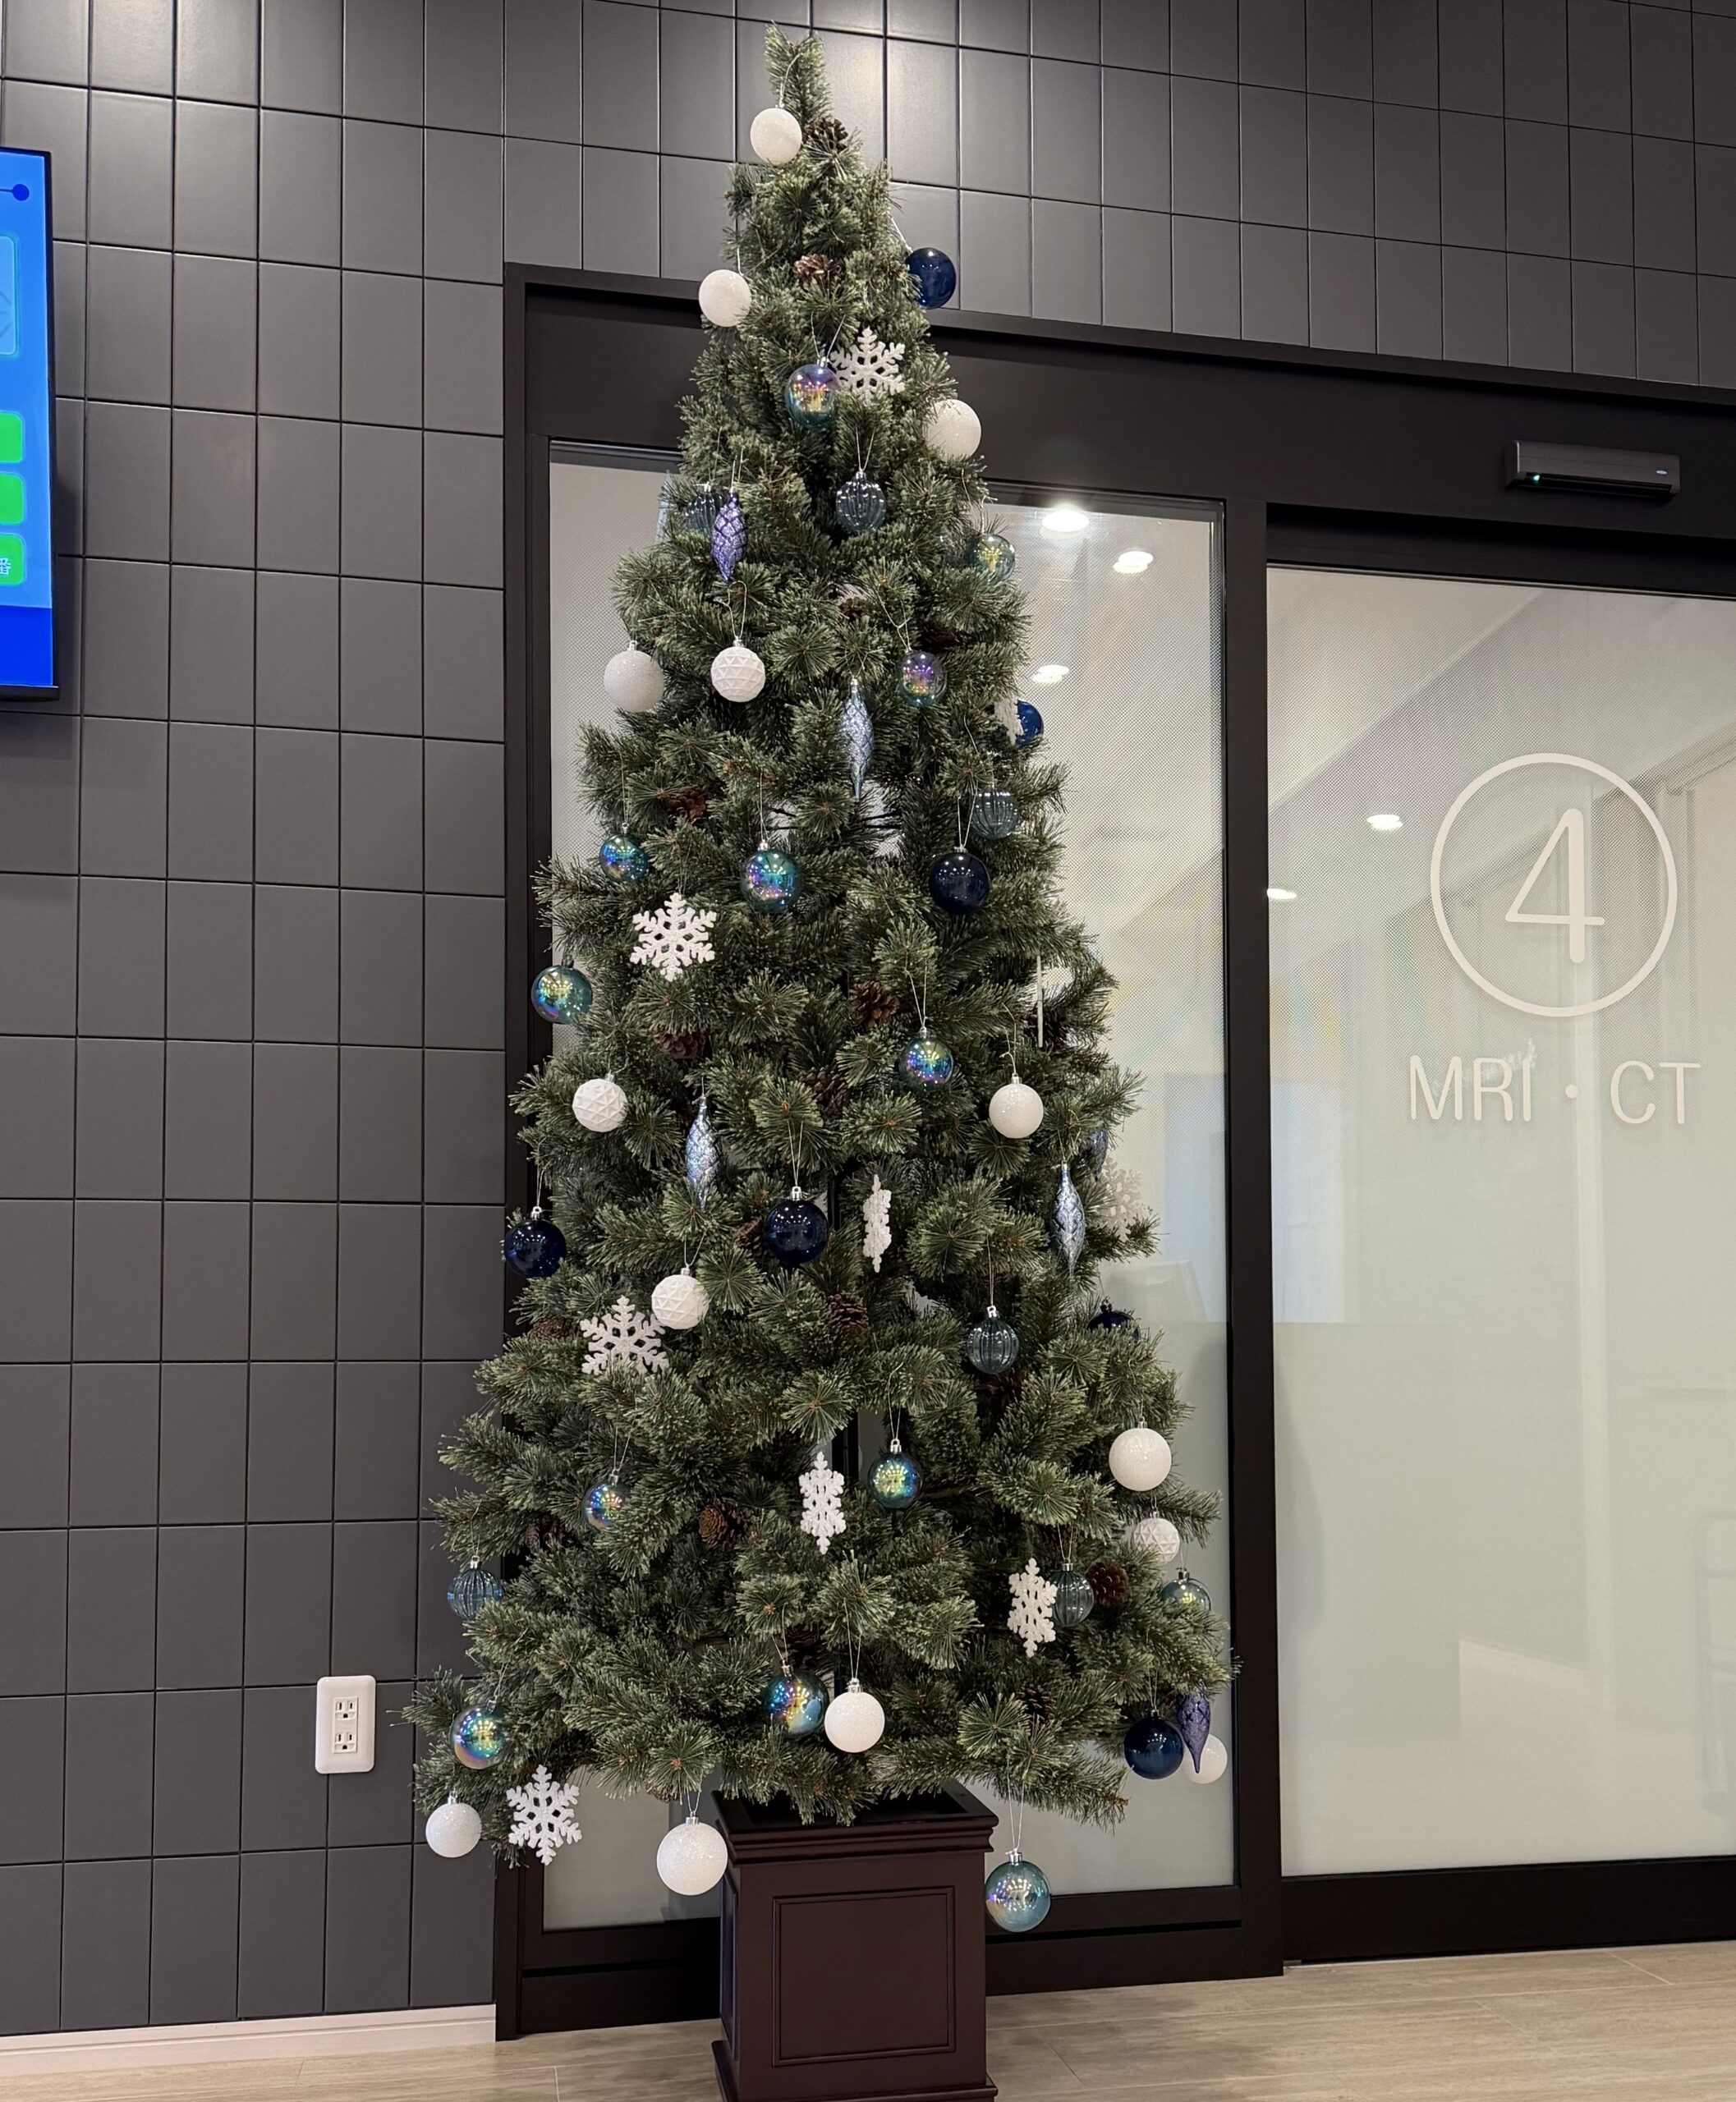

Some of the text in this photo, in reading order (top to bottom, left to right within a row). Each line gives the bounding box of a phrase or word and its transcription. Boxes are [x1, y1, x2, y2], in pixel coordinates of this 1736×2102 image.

[1504, 808, 1605, 963] 4
[1409, 1054, 1532, 1122] MRI
[1610, 1060, 1702, 1126] CT
